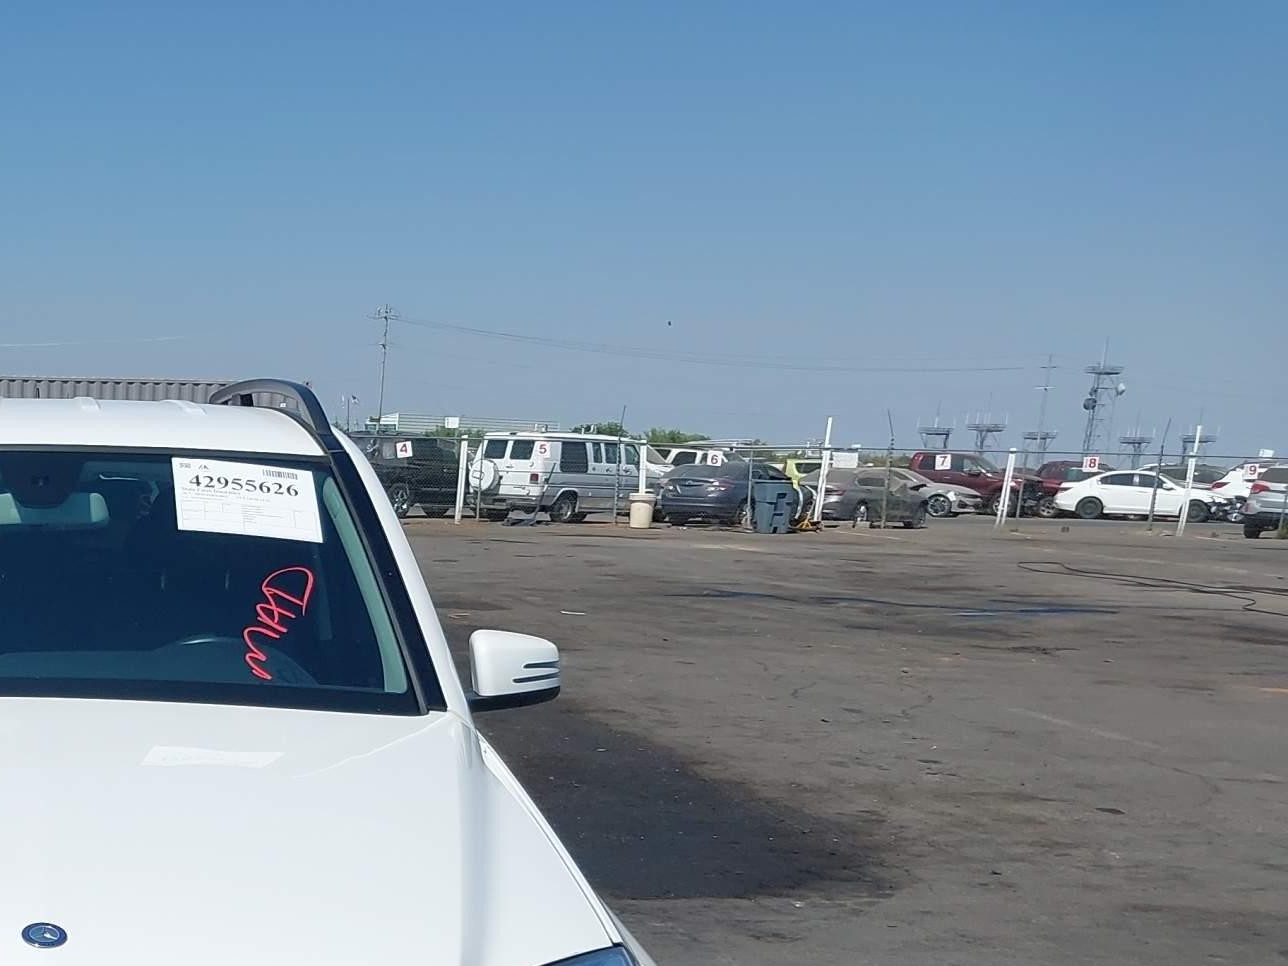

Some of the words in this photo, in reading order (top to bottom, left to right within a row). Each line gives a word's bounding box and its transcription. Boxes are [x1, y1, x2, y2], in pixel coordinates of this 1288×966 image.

[399, 443, 408, 454] 4
[538, 443, 548, 455] 5
[710, 454, 719, 465] 6
[939, 455, 948, 466] 7
[1088, 457, 1097, 469] 8
[1248, 465, 1257, 475] 9
[189, 474, 299, 497] 42955626
